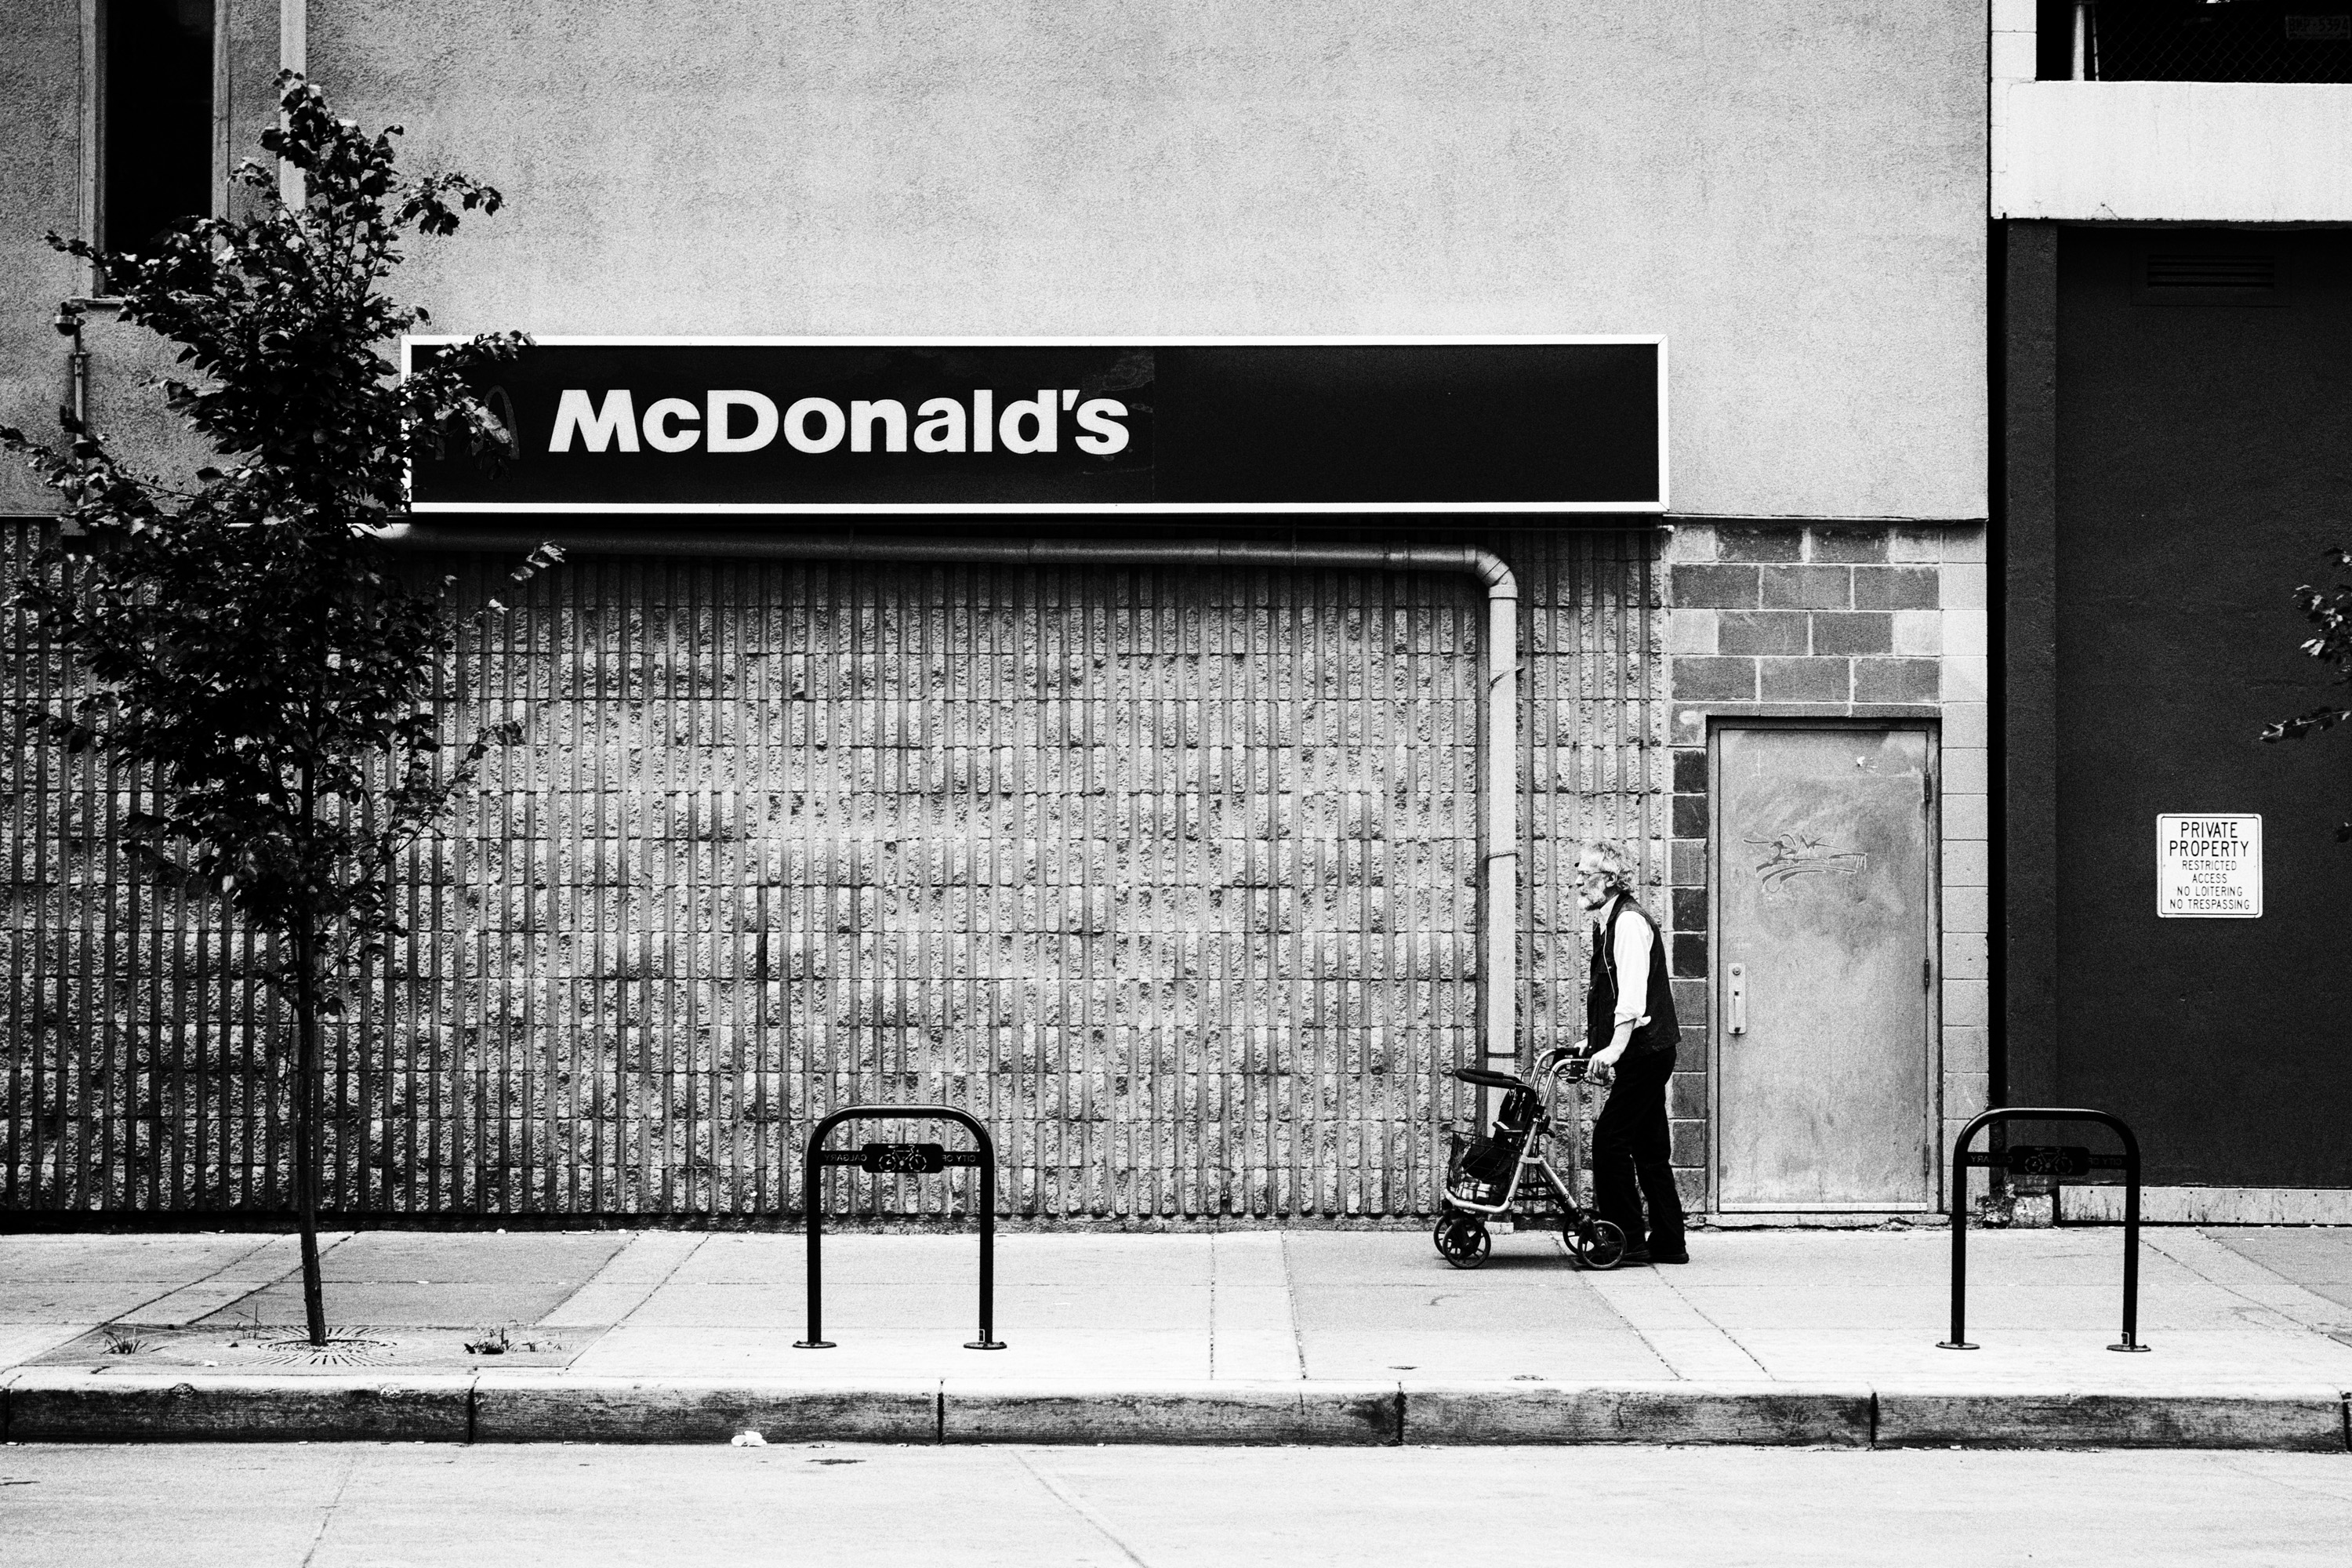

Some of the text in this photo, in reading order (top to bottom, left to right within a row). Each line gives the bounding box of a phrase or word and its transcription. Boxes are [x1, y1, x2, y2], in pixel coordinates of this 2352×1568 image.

[548, 389, 1130, 456] McDonald's
[2180, 821, 2238, 838] PRIVATE
[2169, 840, 2249, 857] PROPERTY
[2182, 860, 2237, 871] RESTRICTED
[2192, 873, 2227, 884] ACCESS
[2177, 886, 2243, 897] NO LOITERING
[2169, 898, 2250, 910] NO TRESPASSING
